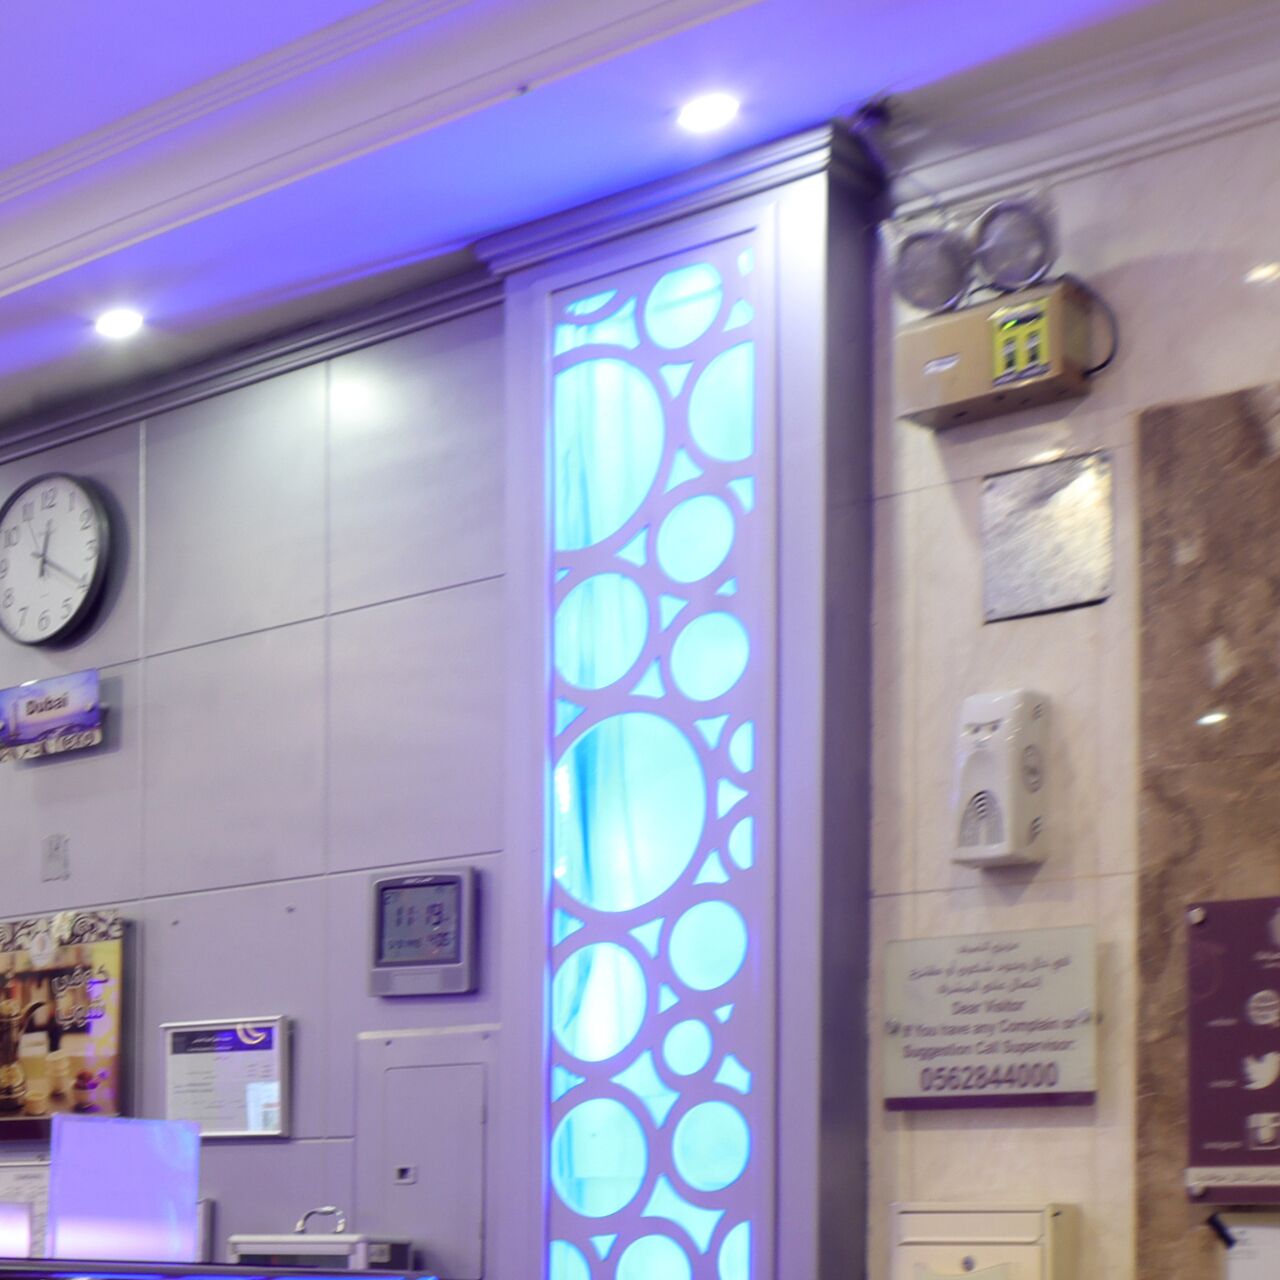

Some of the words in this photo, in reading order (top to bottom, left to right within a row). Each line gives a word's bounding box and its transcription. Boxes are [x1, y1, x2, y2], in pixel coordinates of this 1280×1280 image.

[26, 693, 68, 715] Dubai
[52, 965, 109, 999] كوفي
[56, 999, 107, 1030] شوب
[952, 1001, 981, 1015] Dear
[985, 999, 1027, 1013] Visitor
[941, 1024, 971, 1036] have
[973, 1024, 996, 1037] any
[999, 1018, 1059, 1034] Complain
[903, 1044, 973, 1061] Suggestion
[976, 1041, 1000, 1055] Call
[921, 1062, 1058, 1091] 0562844000
